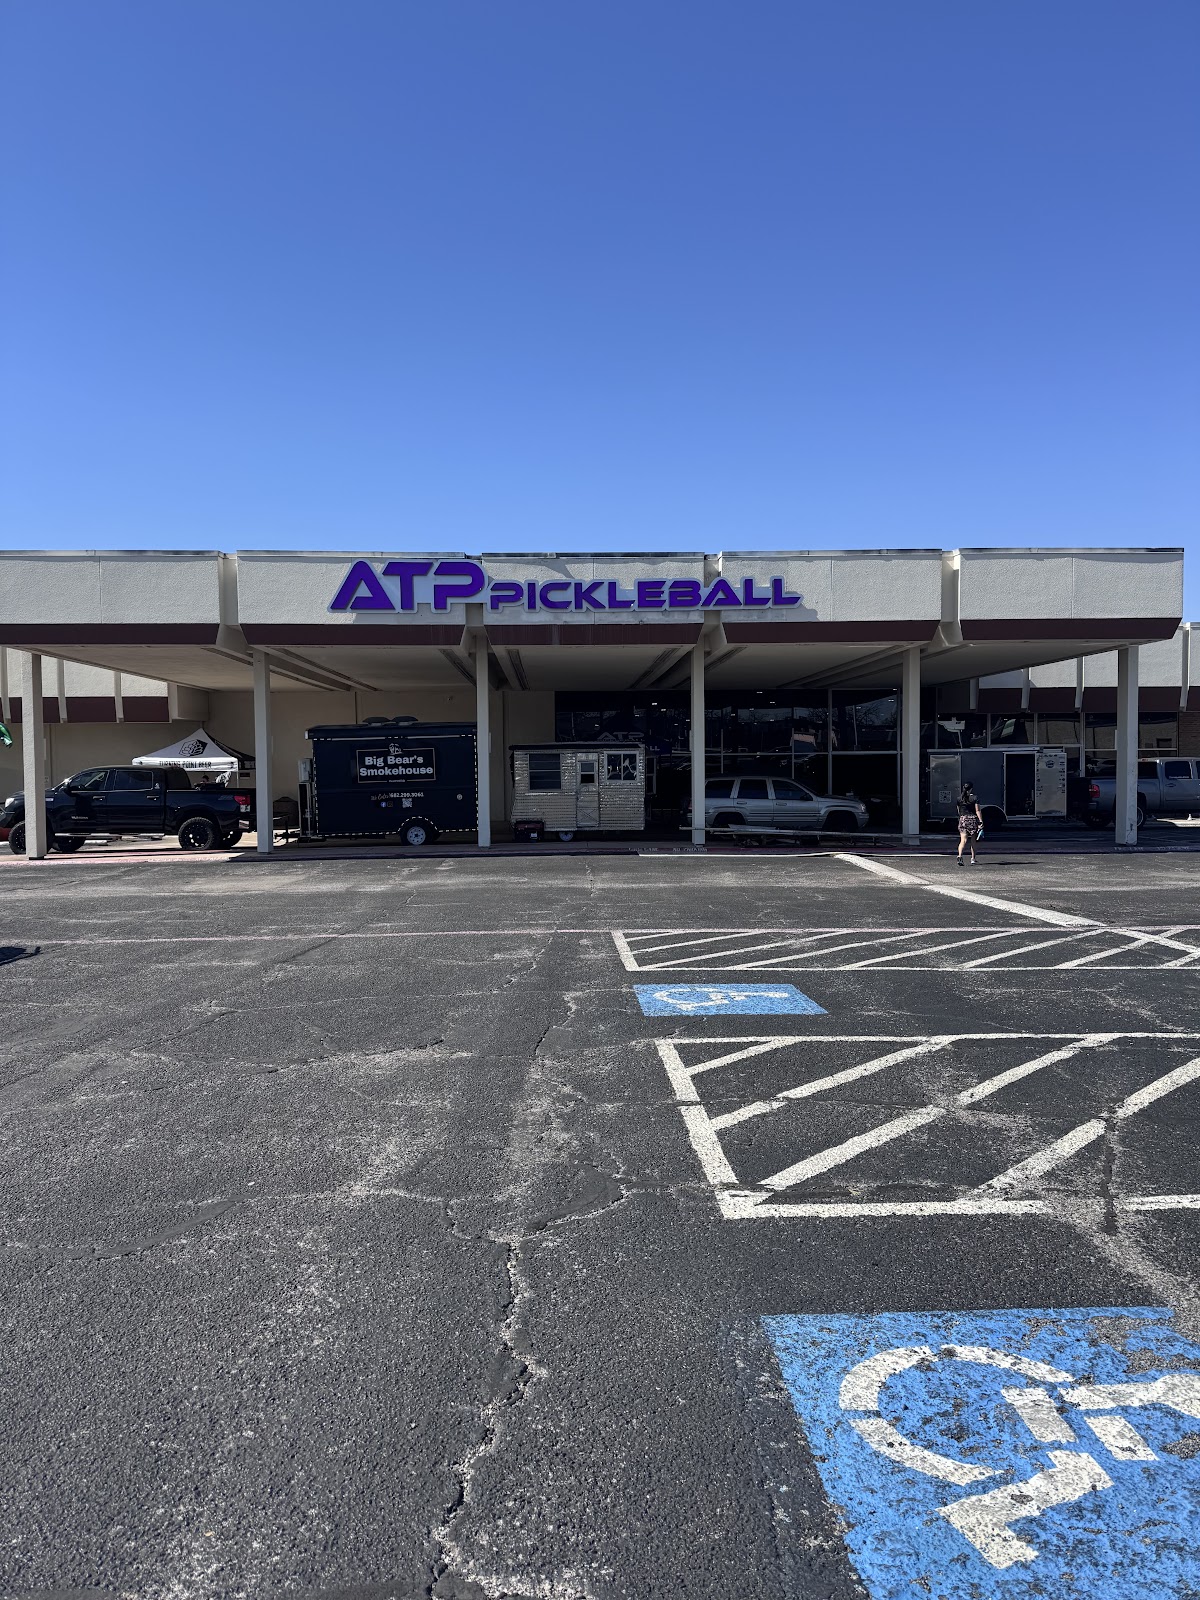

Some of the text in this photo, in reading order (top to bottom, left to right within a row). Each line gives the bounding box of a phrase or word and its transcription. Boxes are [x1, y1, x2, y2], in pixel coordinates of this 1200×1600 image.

[329, 560, 802, 611] ATP PICKLEBALL
[182, 761, 197, 769] POINT
[365, 755, 424, 767] Big Bear's
[359, 766, 434, 776] Smokehouse
